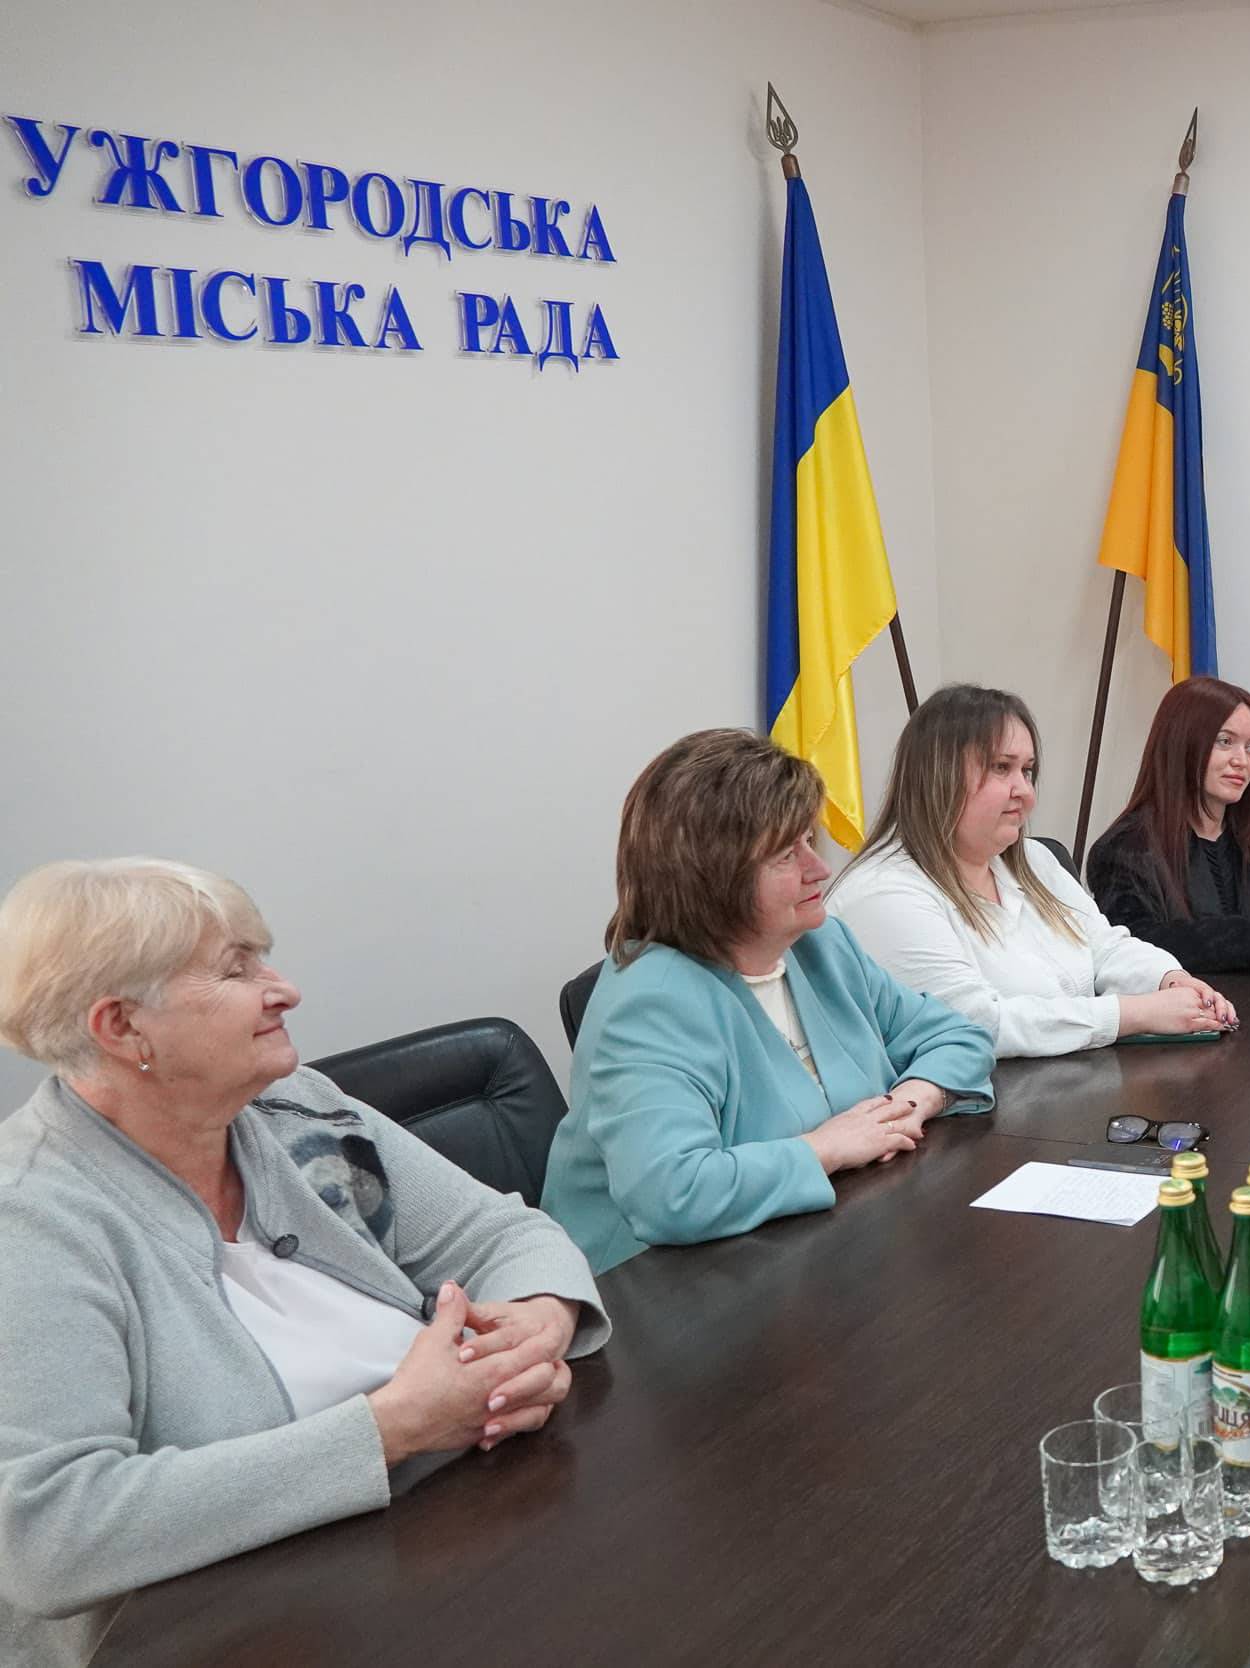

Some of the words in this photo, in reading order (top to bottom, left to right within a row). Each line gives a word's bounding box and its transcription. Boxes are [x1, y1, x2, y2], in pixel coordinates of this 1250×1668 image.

[6, 115, 617, 264] УЖГОРОДСЬКА
[70, 259, 424, 353] МІСЬКА
[458, 290, 621, 373] РАДА
